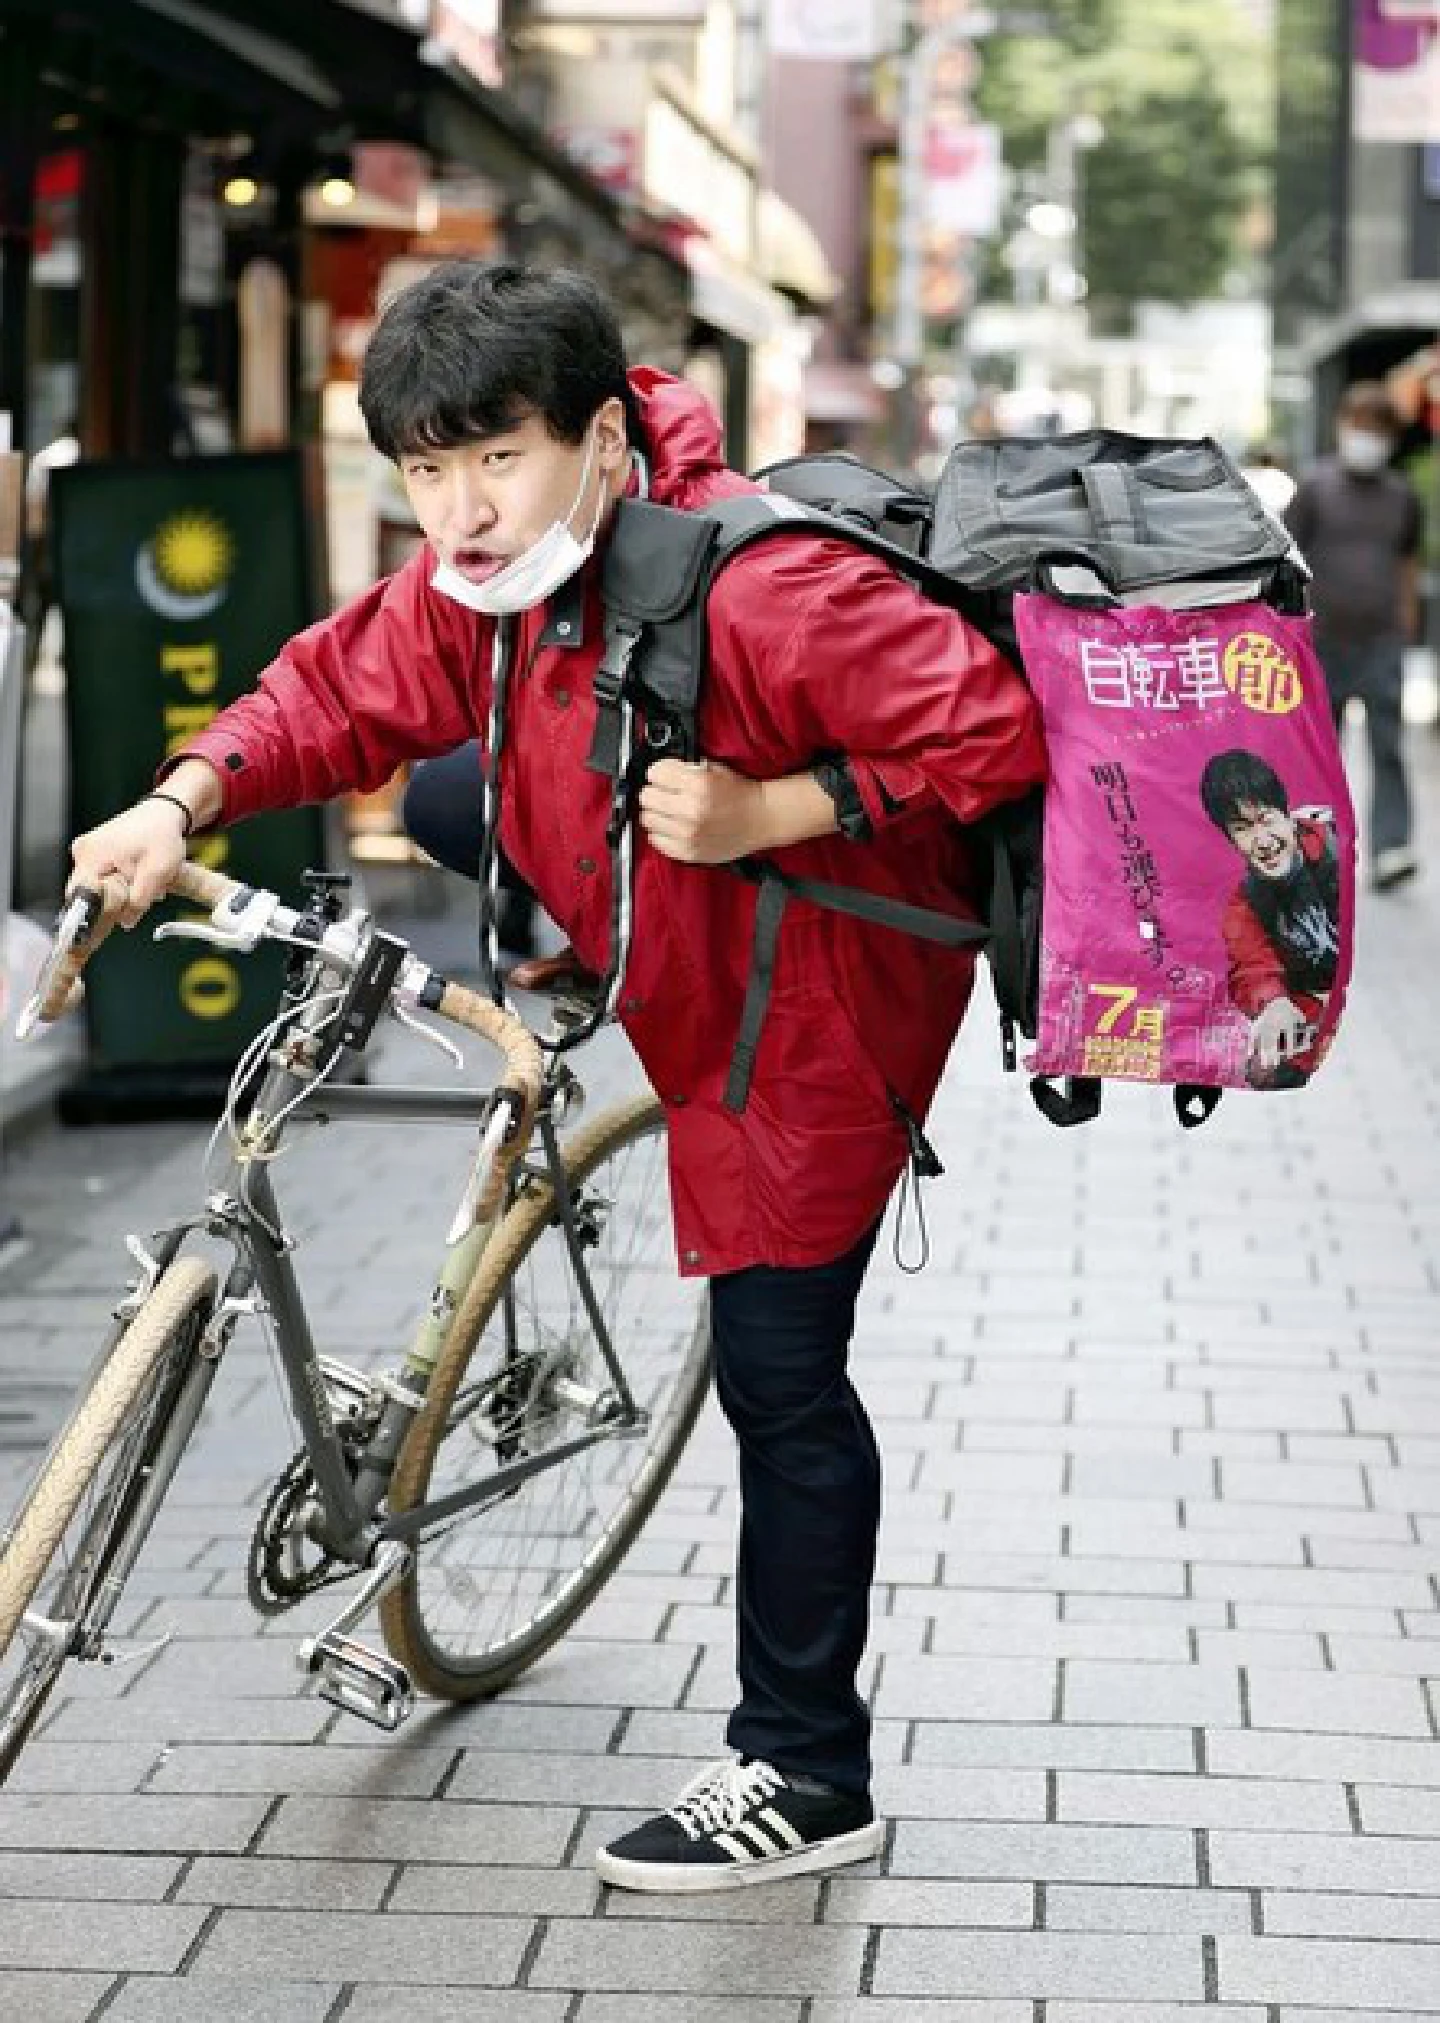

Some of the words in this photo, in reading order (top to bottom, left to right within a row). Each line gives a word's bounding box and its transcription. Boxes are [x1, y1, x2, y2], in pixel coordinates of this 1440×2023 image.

[1079, 631, 1304, 714] 自転車節
[1089, 983, 1165, 1040] 7月
